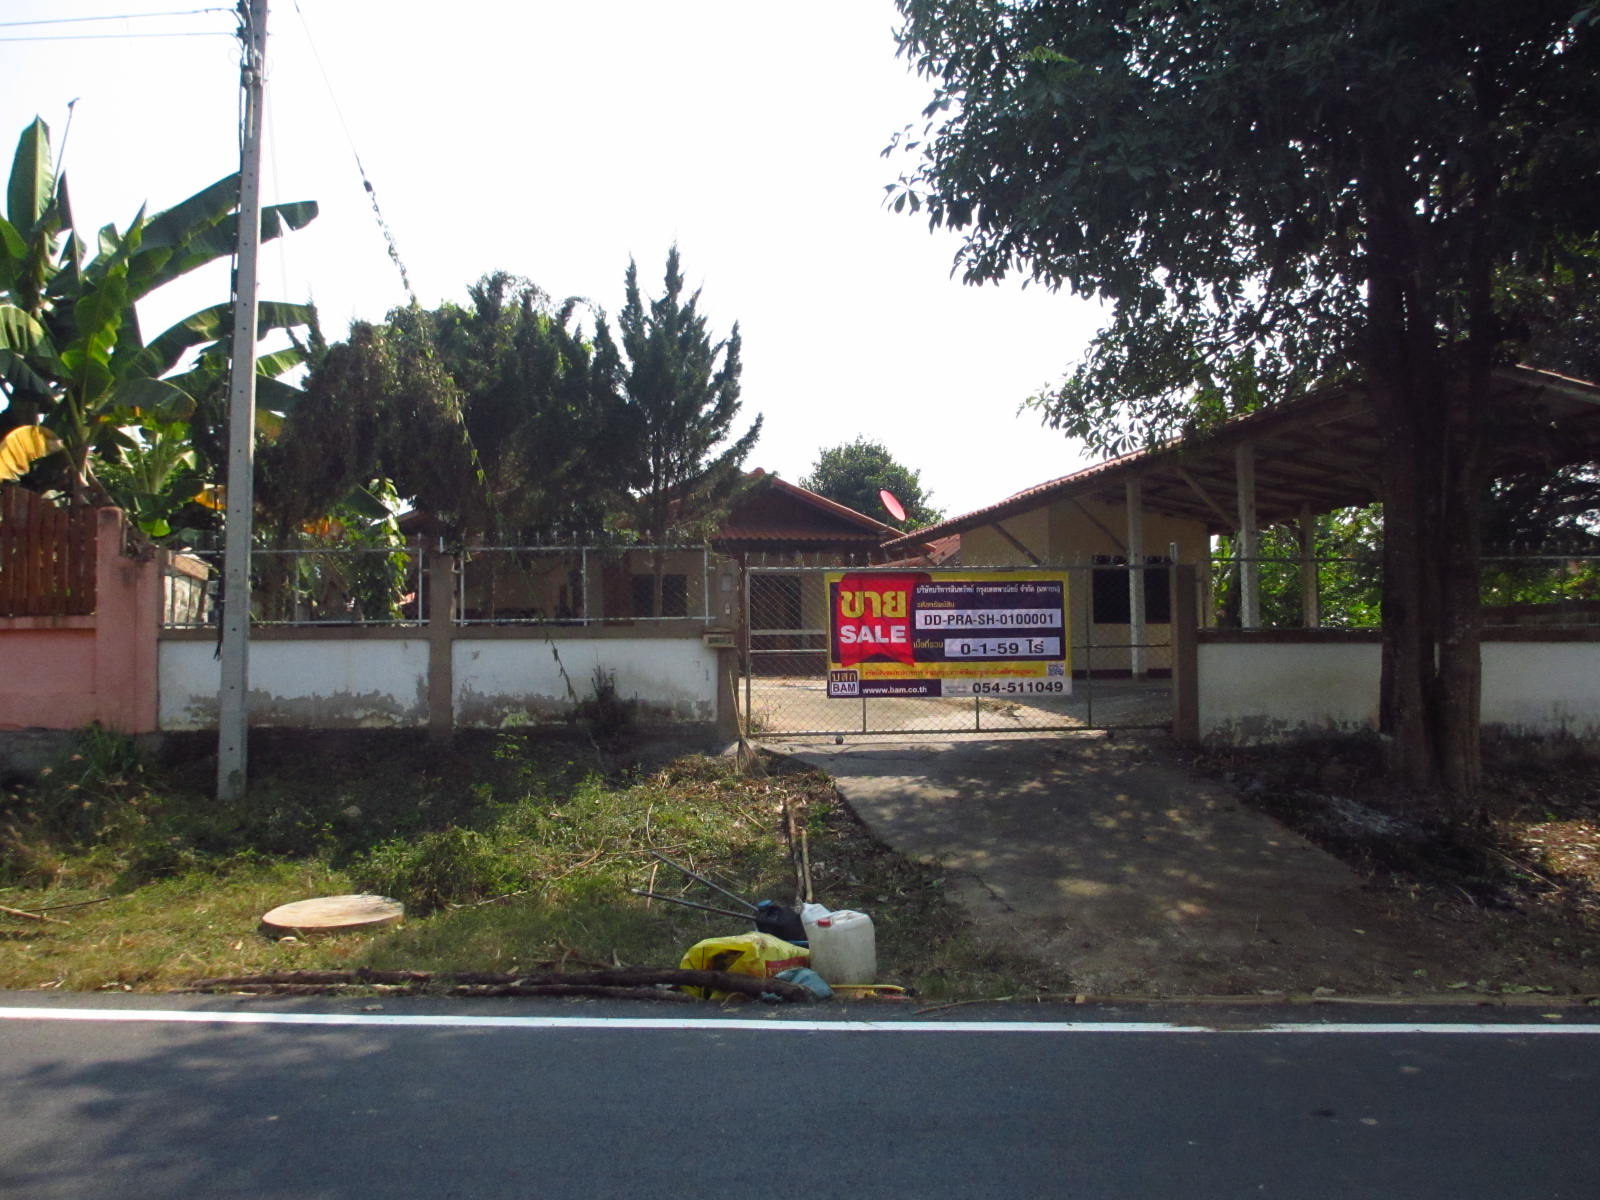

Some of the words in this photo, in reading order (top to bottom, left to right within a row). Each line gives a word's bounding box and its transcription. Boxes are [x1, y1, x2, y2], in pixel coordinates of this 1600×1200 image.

[840, 590, 907, 618] ขาย
[924, 613, 1054, 626] DD-PRA-SH-0100001
[840, 625, 907, 644] SALE
[960, 643, 1020, 655] 0-1-59
[1026, 639, 1045, 654] ไร่
[832, 683, 857, 693] BAM
[862, 685, 928, 694] www.bam.co.th
[972, 681, 1064, 694] 054-511049
